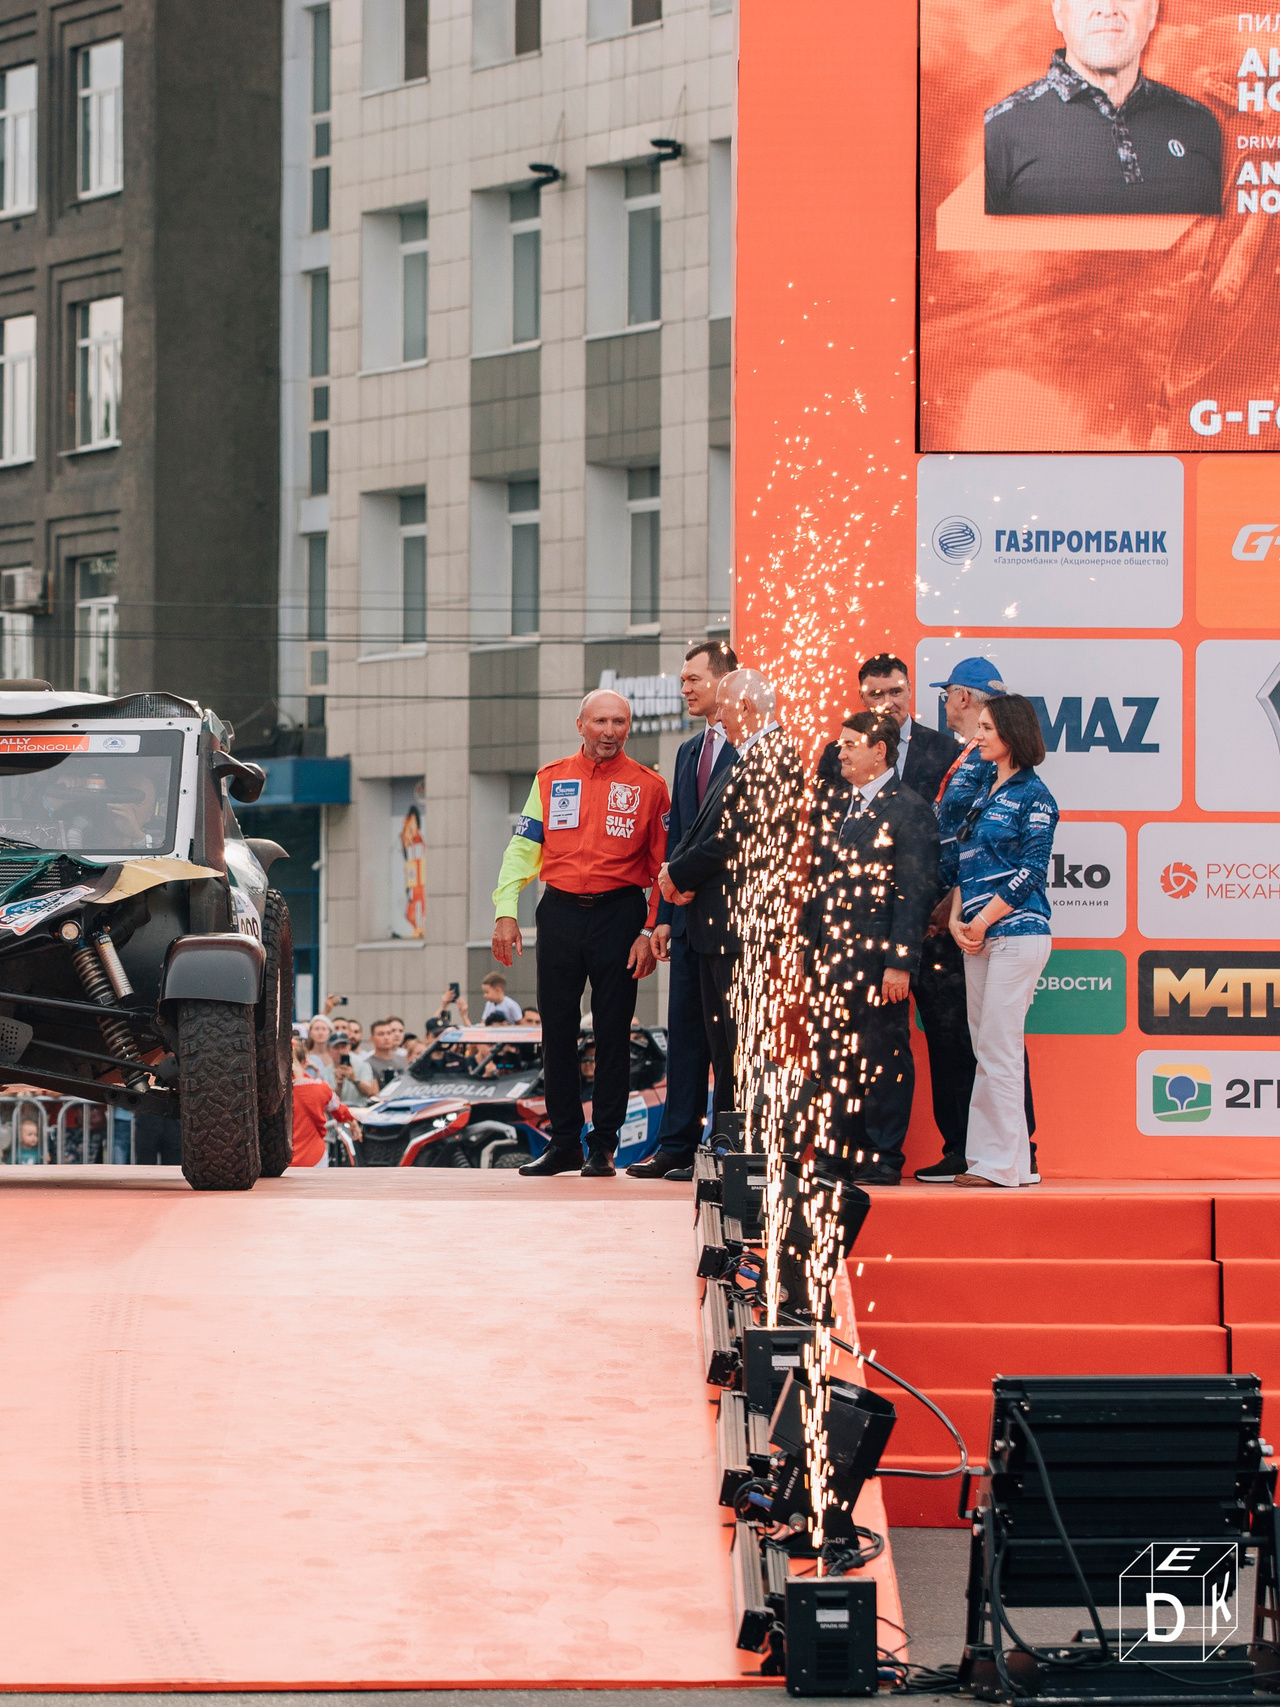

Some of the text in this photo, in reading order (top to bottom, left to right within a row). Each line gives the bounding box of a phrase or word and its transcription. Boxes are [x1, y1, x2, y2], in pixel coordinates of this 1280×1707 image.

[1189, 399, 1280, 436] G-F
[994, 530, 1168, 553] ГАЗПРОМБАНК
[606, 815, 636, 829] SILK
[605, 825, 635, 839] WAY
[1034, 976, 1112, 991] ОВОСТИ
[401, 1083, 496, 1098] MONGOLIA
